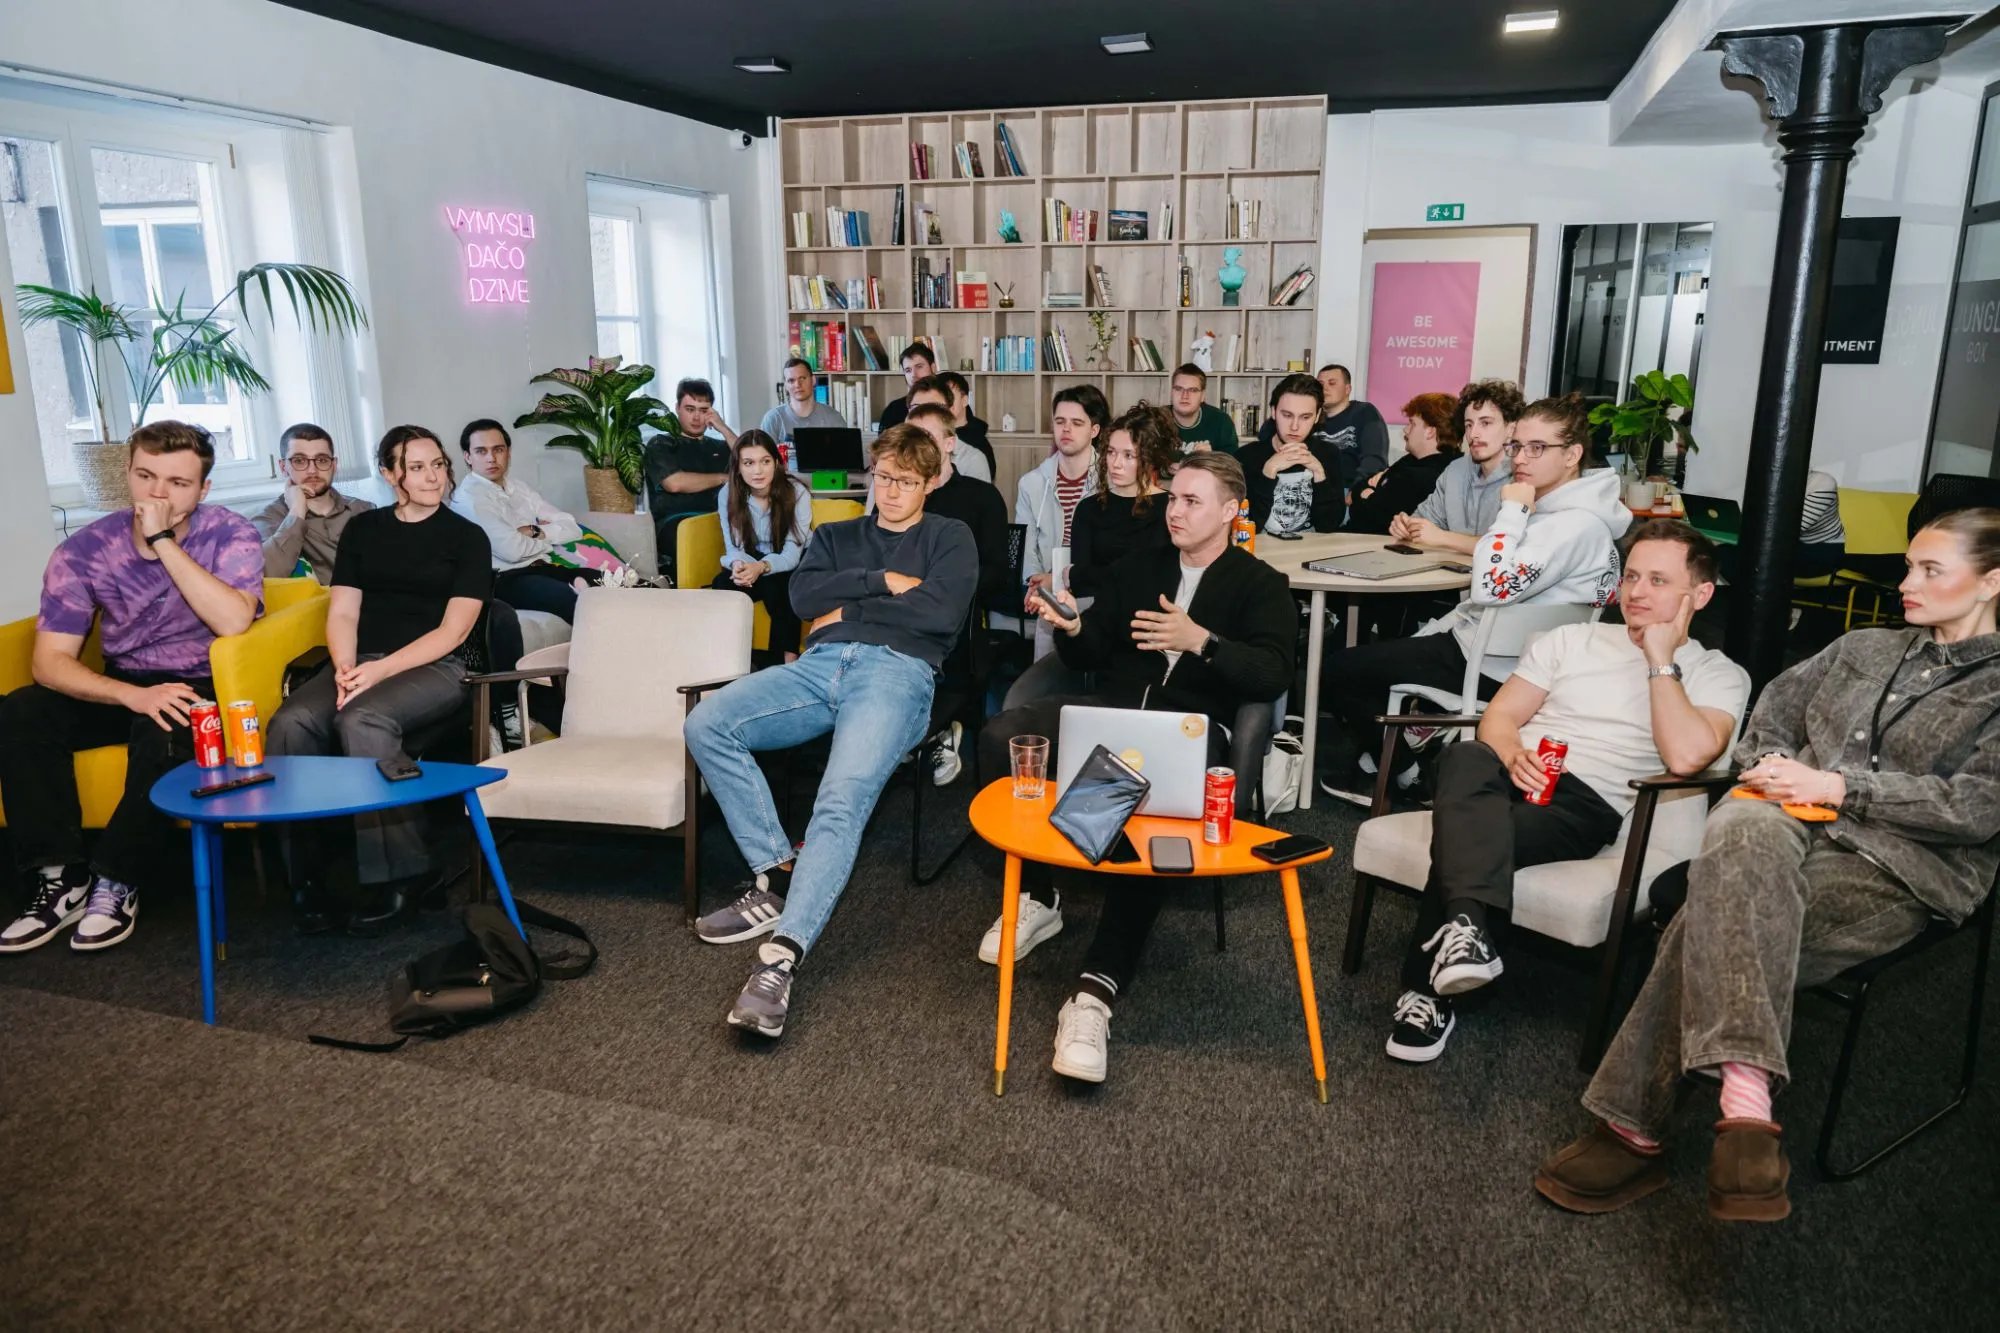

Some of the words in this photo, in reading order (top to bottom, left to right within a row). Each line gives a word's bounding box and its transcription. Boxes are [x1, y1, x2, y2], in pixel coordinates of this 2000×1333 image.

[446, 206, 535, 239] VYMYSLI
[467, 240, 525, 270] DAČO
[1414, 315, 1433, 328] BE
[1385, 336, 1459, 348] AWESOME
[1823, 340, 1876, 351] ITMENT
[1397, 356, 1444, 369] TODAY
